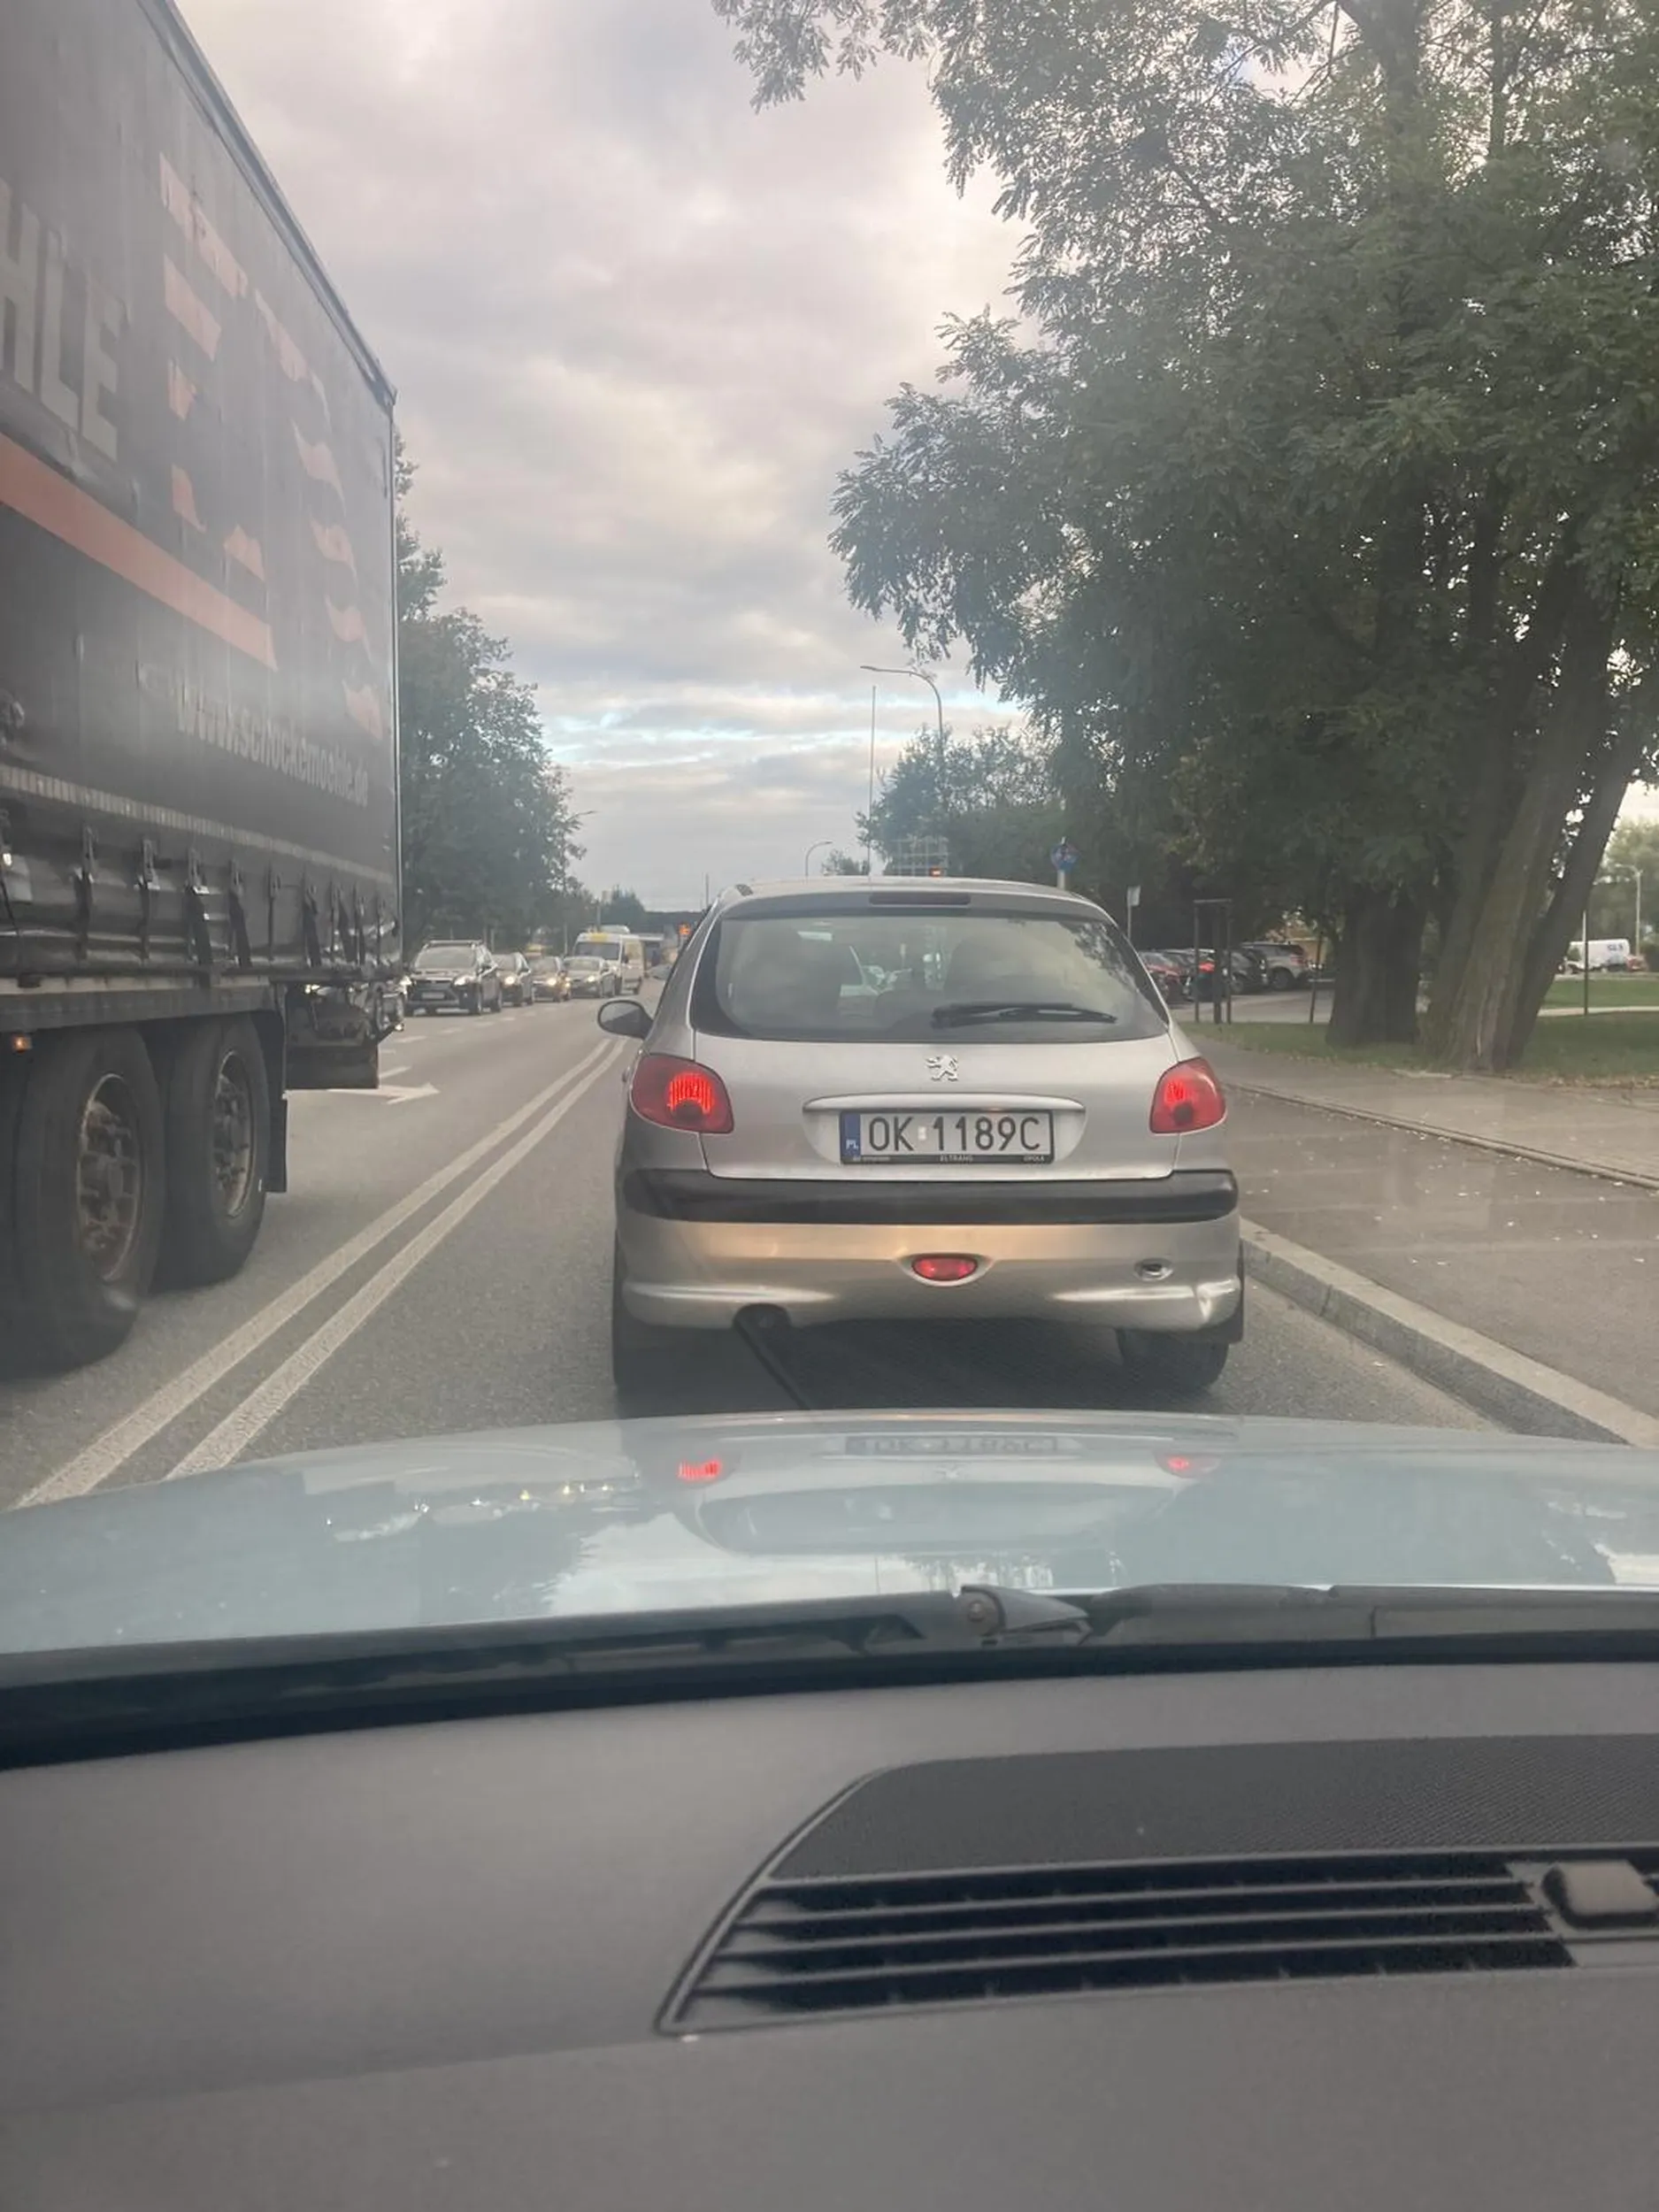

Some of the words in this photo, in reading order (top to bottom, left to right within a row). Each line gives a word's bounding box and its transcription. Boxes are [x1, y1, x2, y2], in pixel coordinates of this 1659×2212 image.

[846, 1139, 859, 1150] PL
[868, 1116, 915, 1152] OK
[933, 1115, 1041, 1152] 1189C
